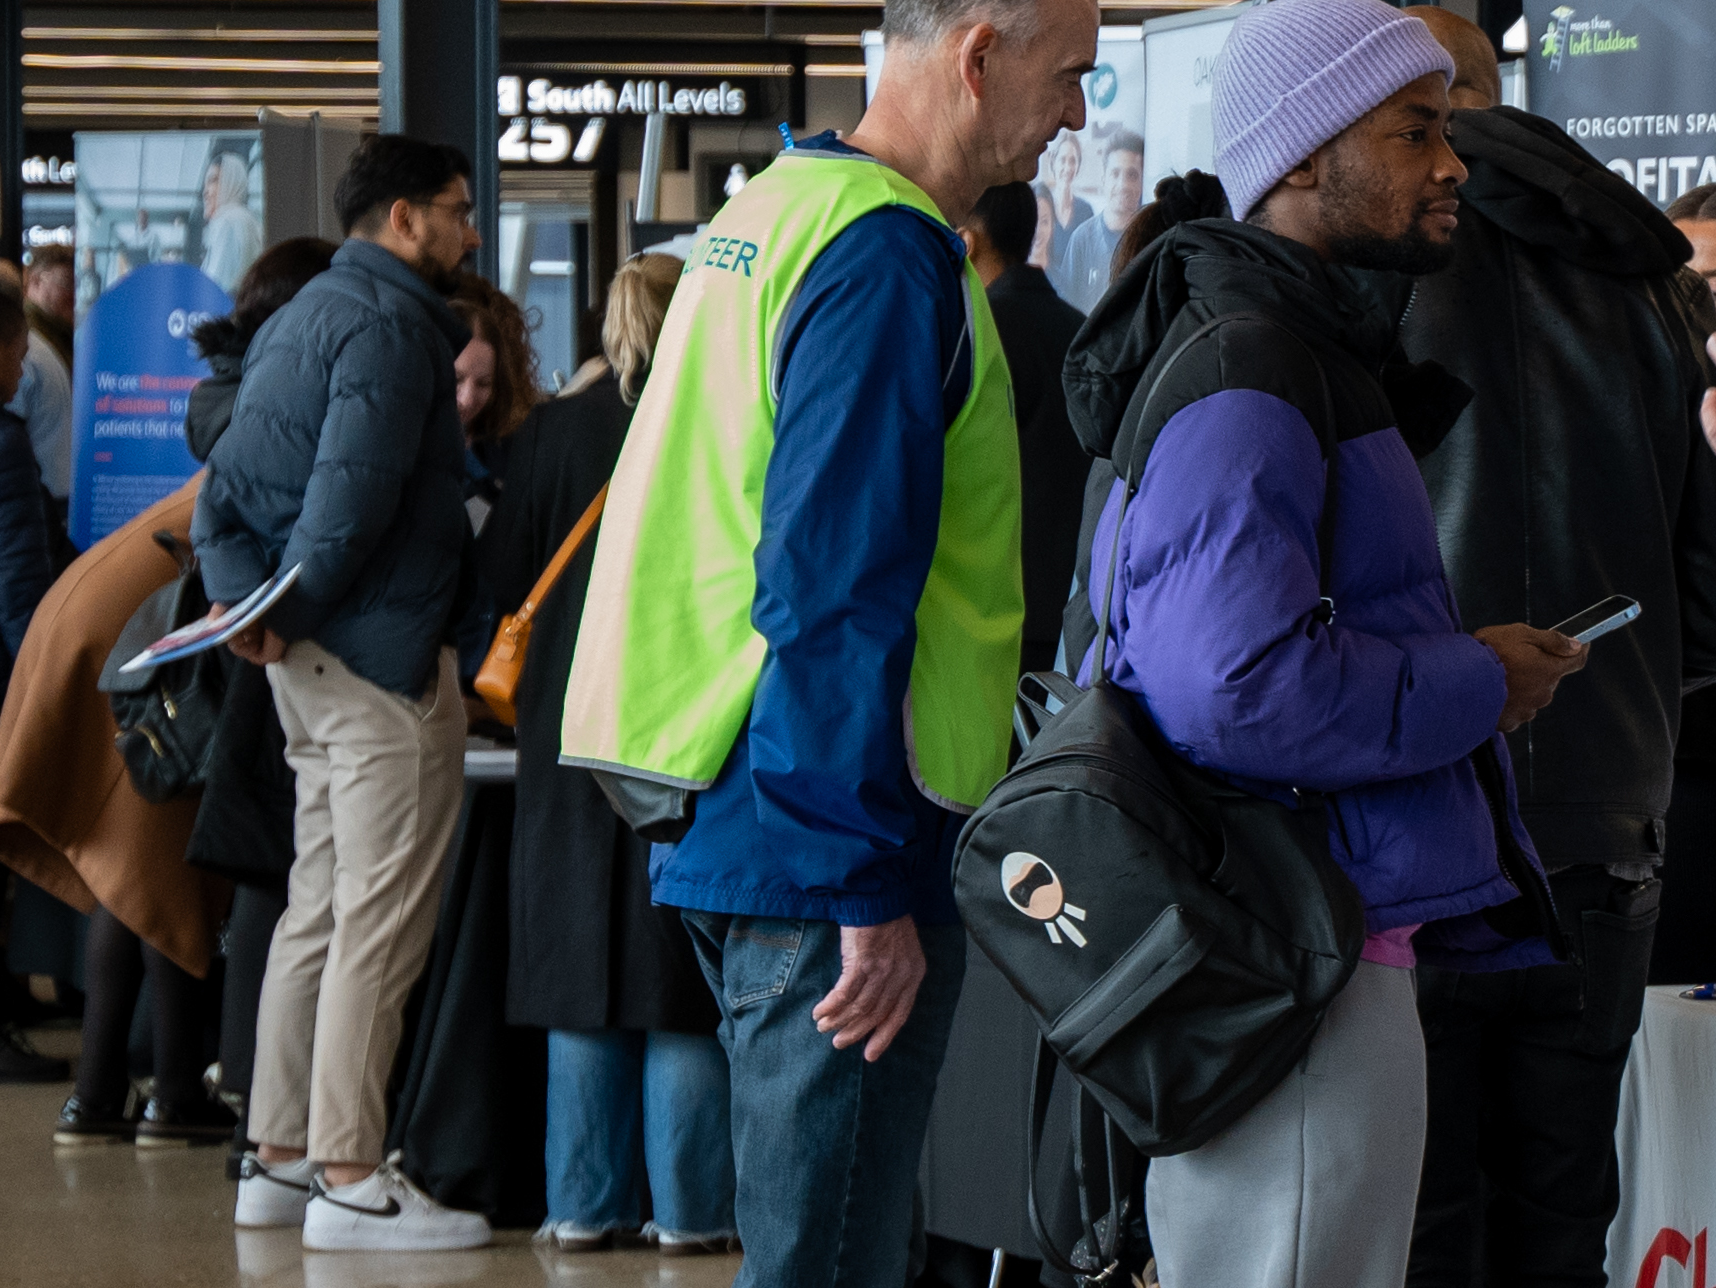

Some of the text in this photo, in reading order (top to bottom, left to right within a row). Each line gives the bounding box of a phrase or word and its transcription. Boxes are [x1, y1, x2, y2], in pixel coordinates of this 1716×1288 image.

[1569, 13, 1612, 31] more than
[1569, 28, 1639, 55] loft ladders
[527, 78, 746, 115] South All Levels
[1566, 114, 1679, 138] FORGOTTEN
[95, 371, 115, 392] We
[117, 374, 139, 392] are
[94, 418, 142, 440] patients
[144, 418, 169, 439] that
